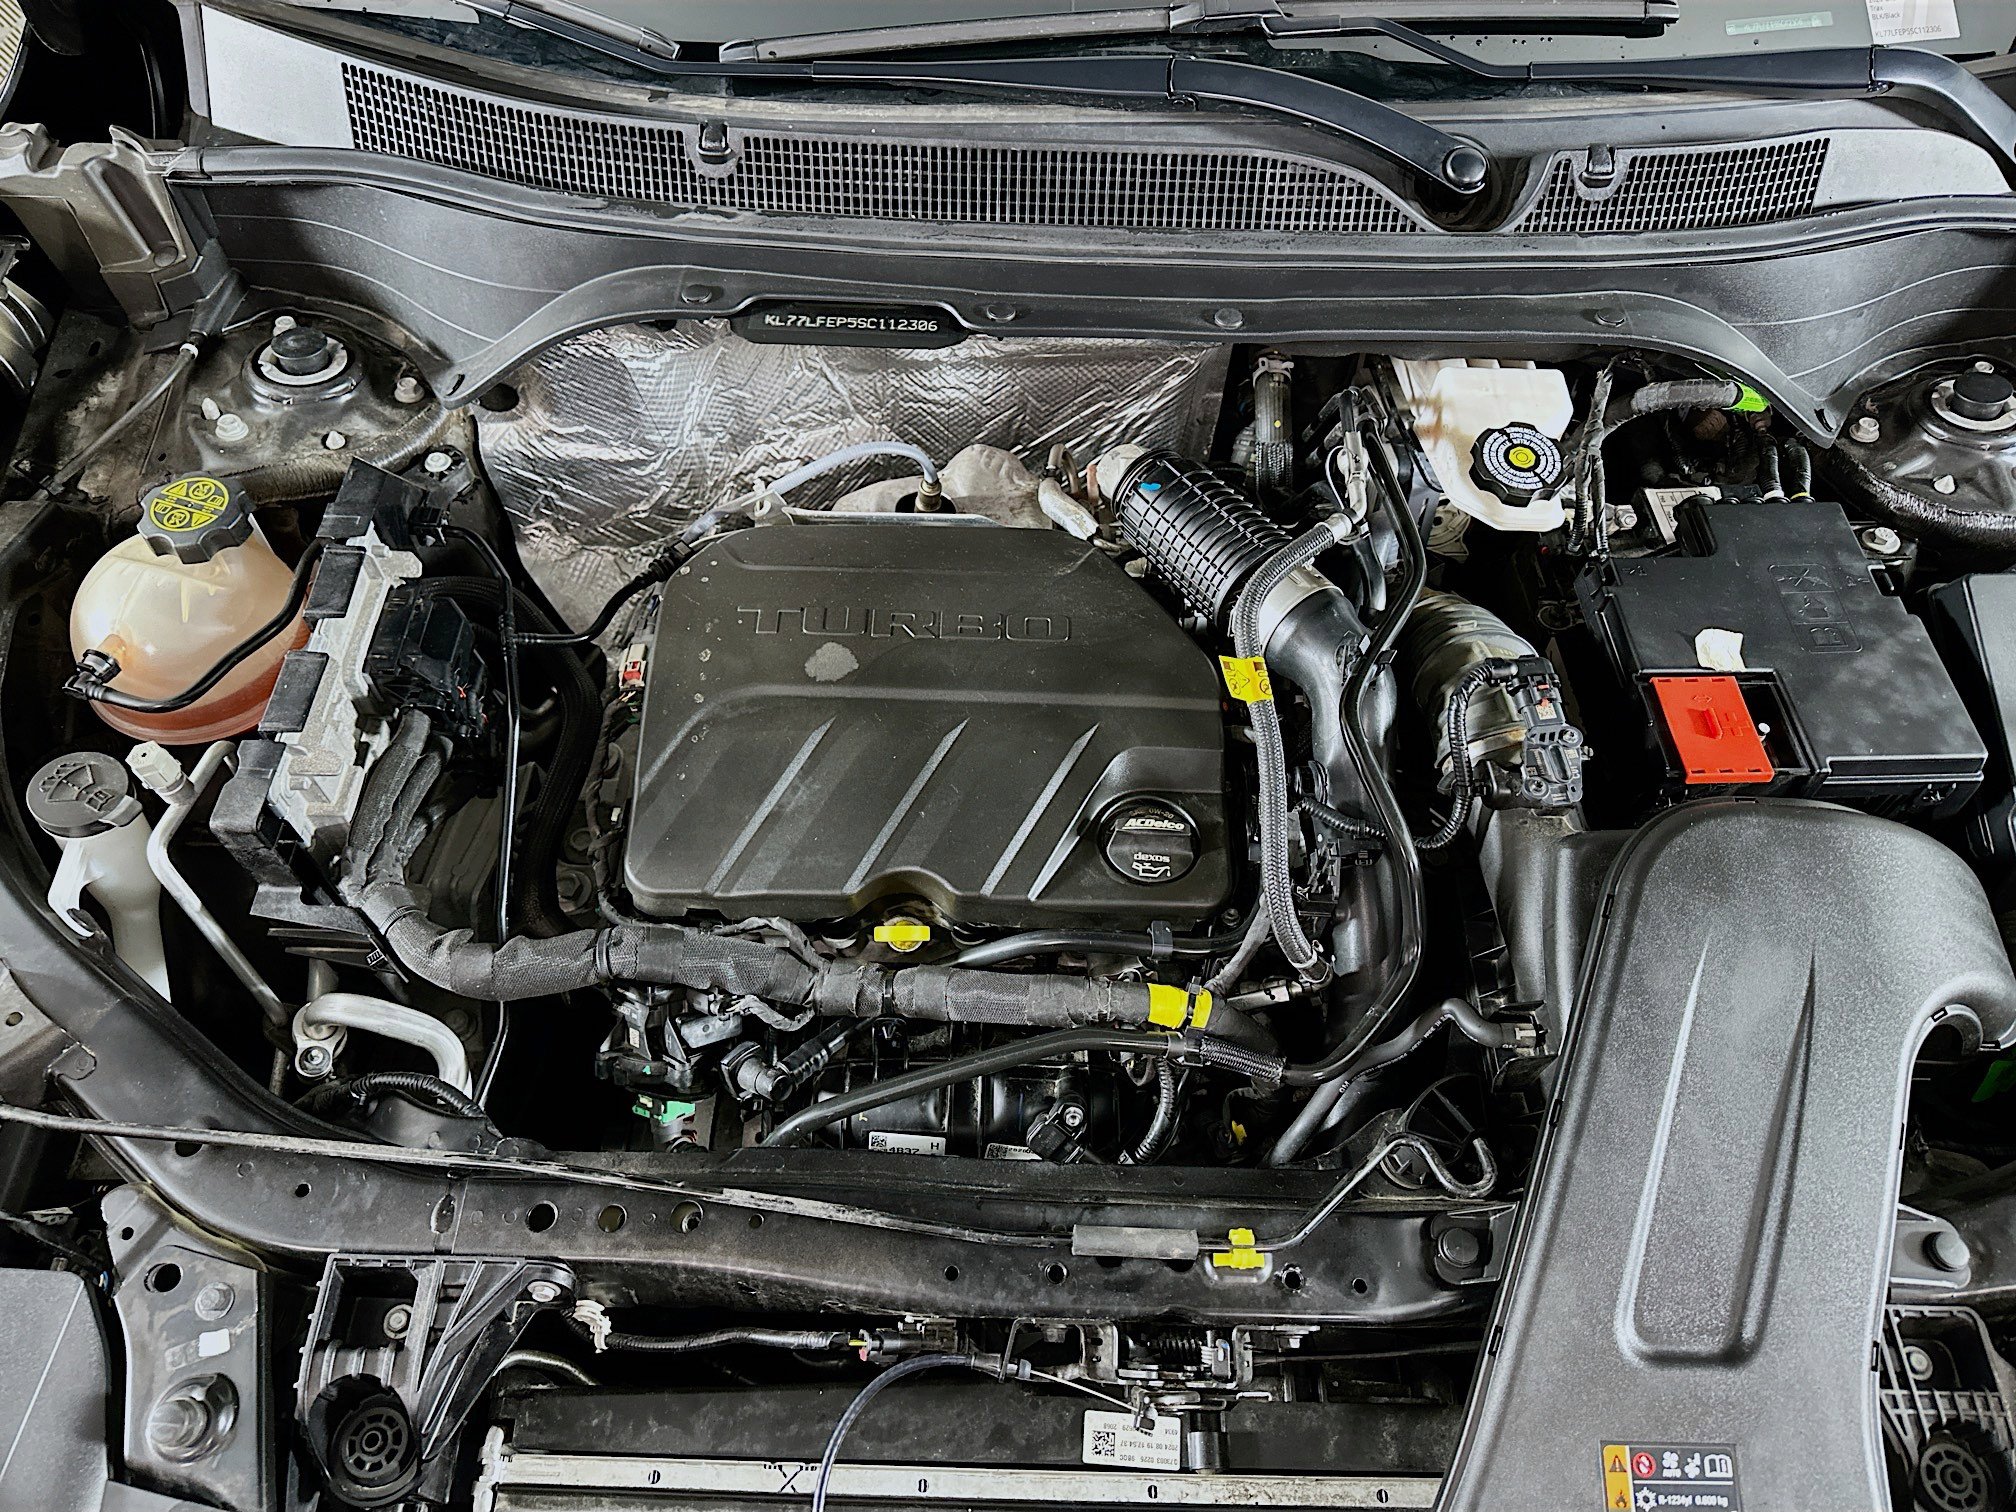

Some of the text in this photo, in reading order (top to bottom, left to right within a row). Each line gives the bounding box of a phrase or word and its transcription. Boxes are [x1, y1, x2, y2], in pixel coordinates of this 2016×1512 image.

[764, 314, 938, 331] KL77LFEP5SC112306
[737, 605, 1072, 642] TURBO
[1122, 818, 1185, 830] ACDelco
[1133, 852, 1171, 863] dexos
[930, 1142, 940, 1150] H
